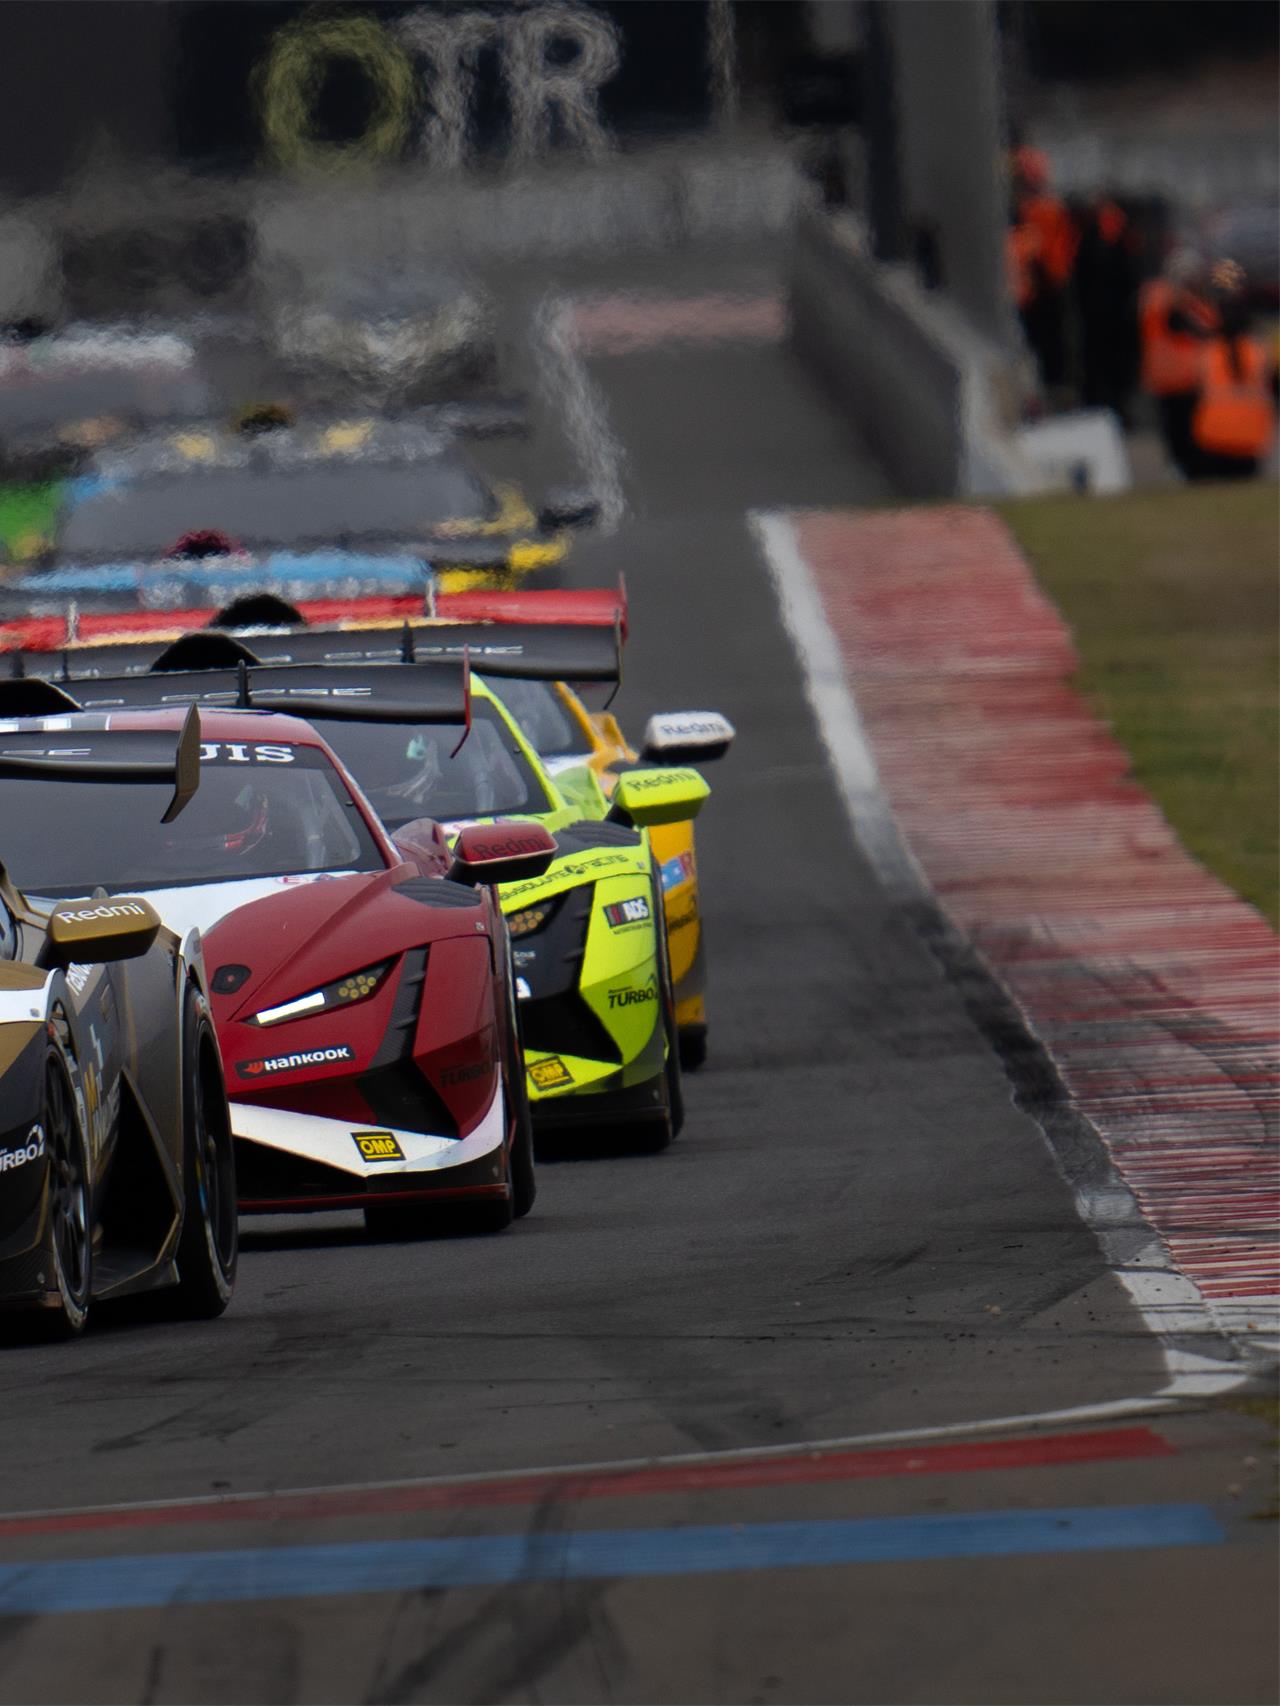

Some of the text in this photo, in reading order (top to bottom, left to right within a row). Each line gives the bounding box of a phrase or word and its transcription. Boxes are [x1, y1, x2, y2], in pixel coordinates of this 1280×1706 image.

[260, 12, 618, 172] OTR
[472, 836, 548, 859] Redmi
[56, 902, 145, 924] Redmi
[608, 987, 654, 1009] TURBO
[360, 1139, 396, 1154] OMP
